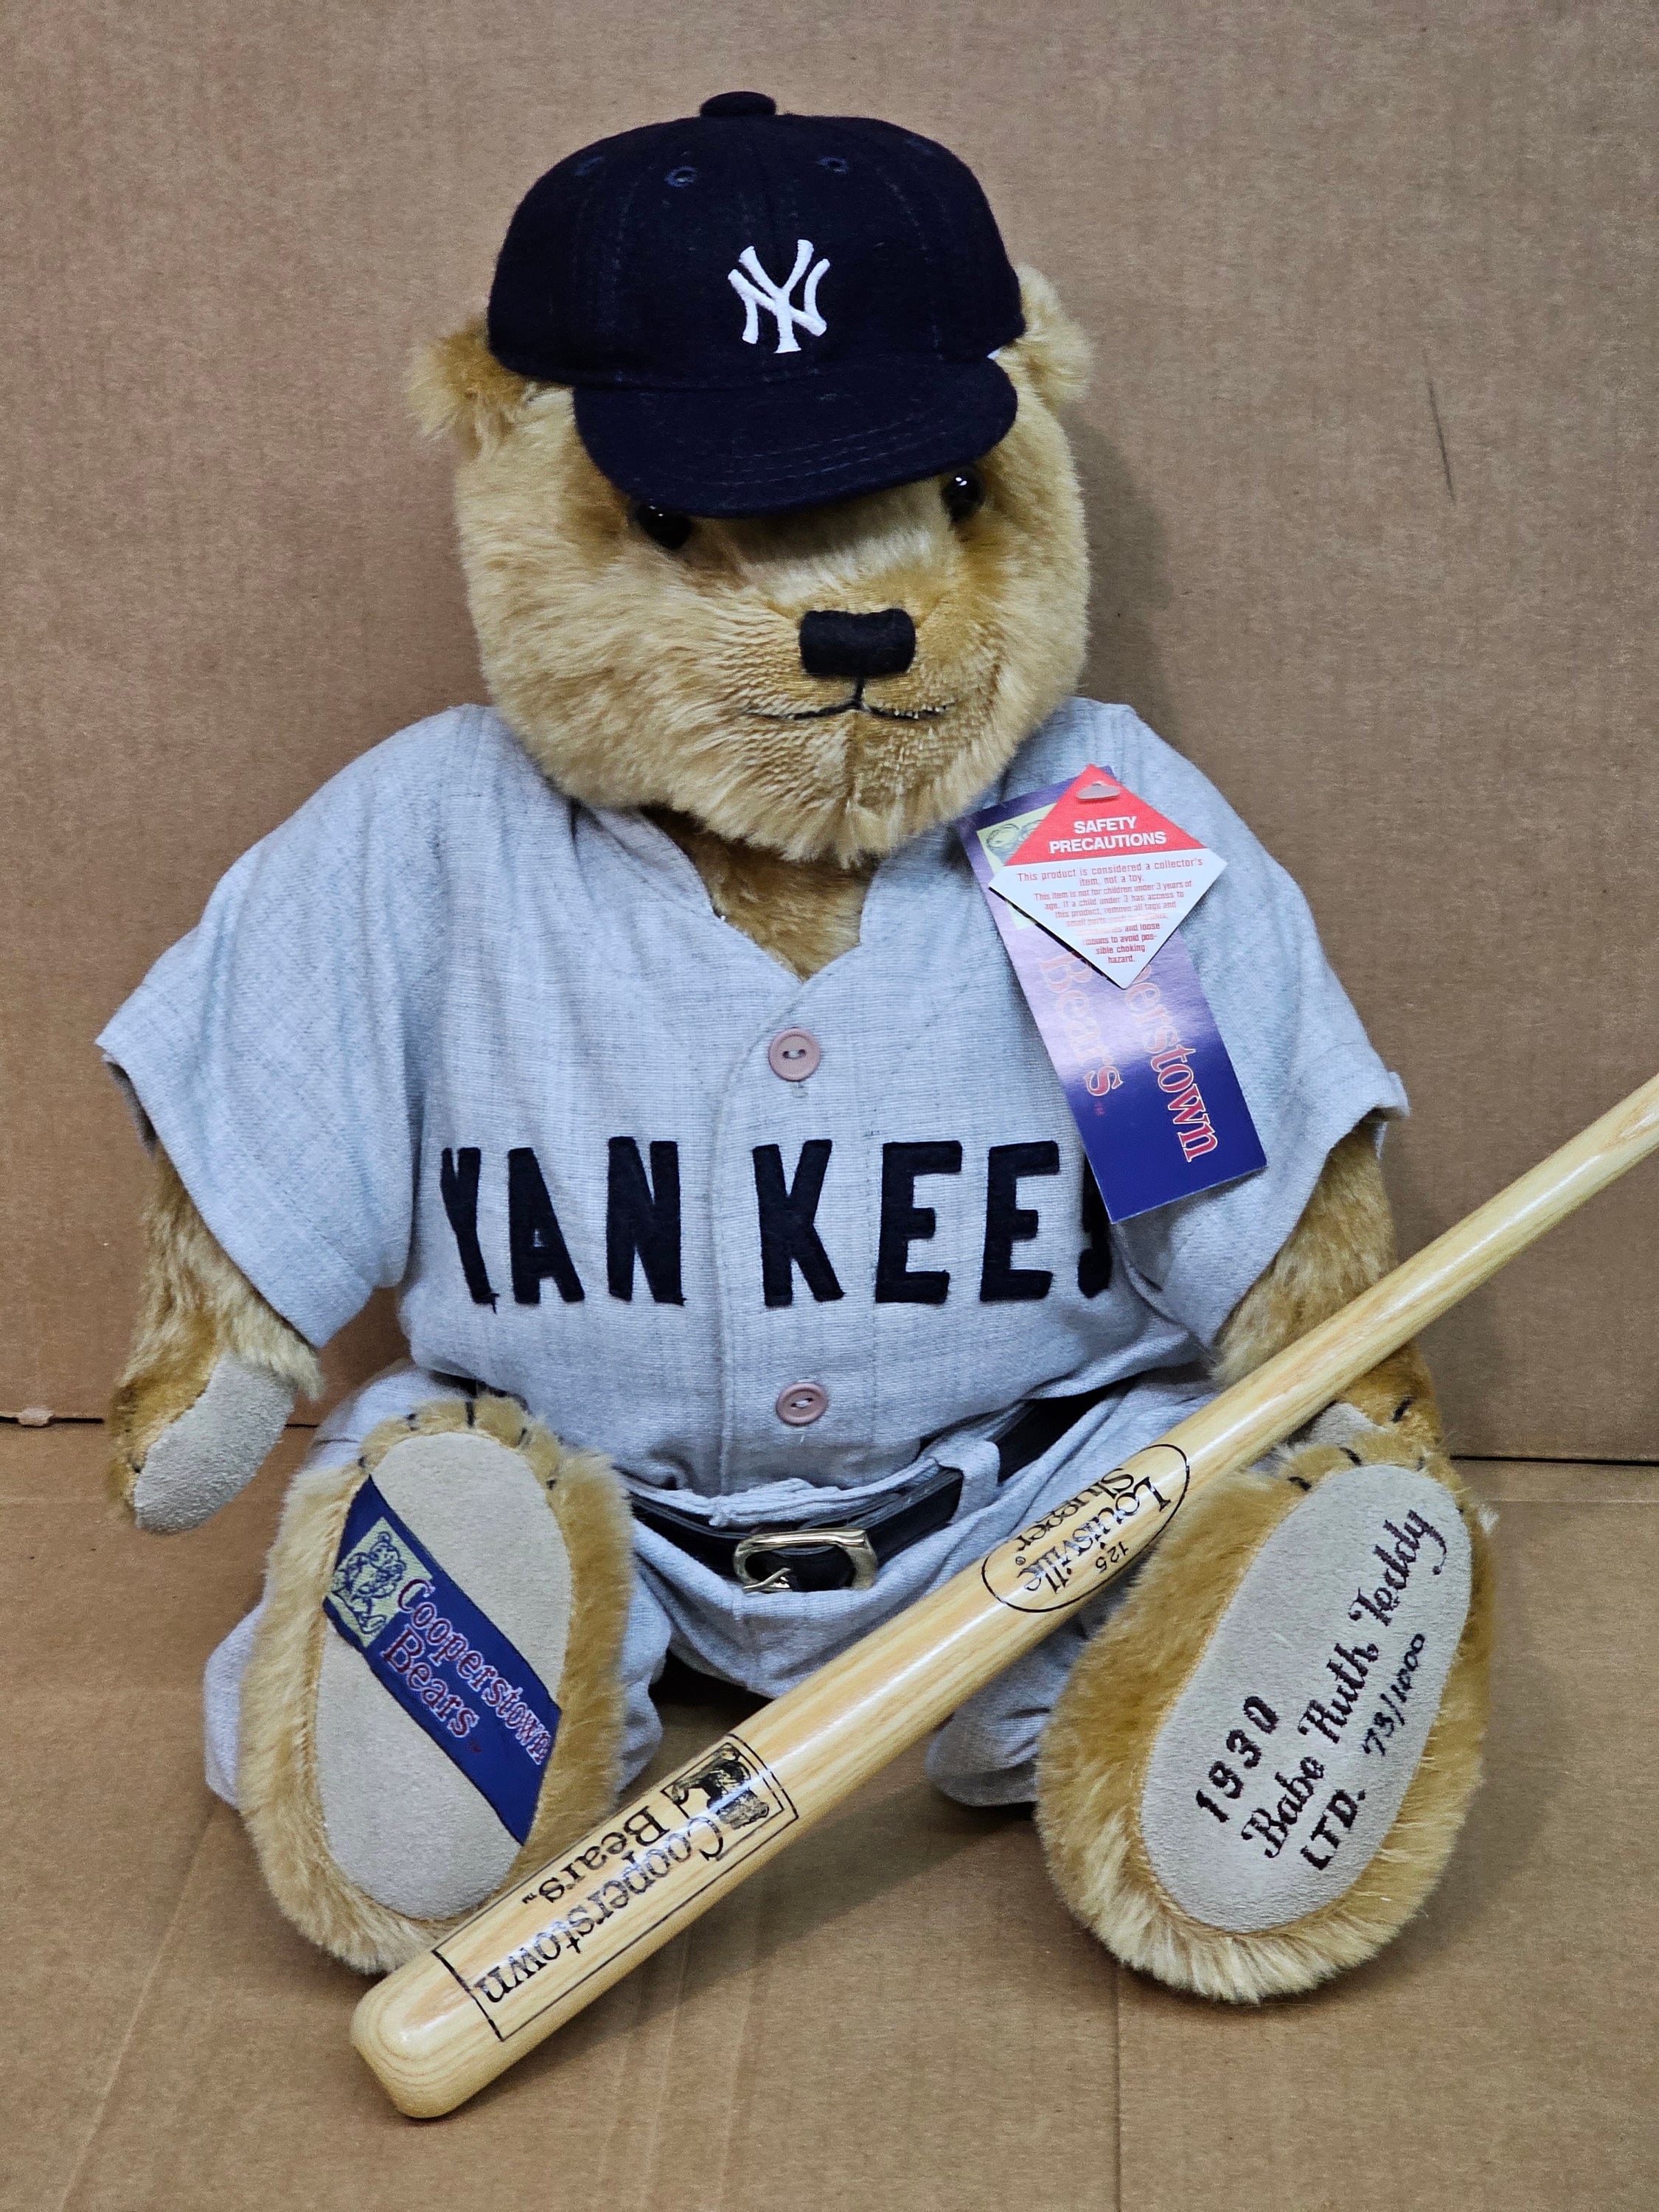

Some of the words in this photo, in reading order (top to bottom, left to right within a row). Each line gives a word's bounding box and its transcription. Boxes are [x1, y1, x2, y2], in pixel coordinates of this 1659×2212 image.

[727, 238, 830, 354] NY
[1074, 815, 1138, 835] SAFETY
[1049, 831, 1167, 854] PRECAUTIONS
[1017, 872, 1038, 882] This
[1042, 869, 1076, 881] product
[1079, 868, 1088, 876] is
[1092, 862, 1142, 875] considered
[1154, 858, 1203, 869] collector's
[1104, 875, 1118, 884] not
[1129, 873, 1145, 883] toy.
[1033, 893, 1051, 901] This
[1052, 891, 1068, 900] item
[1078, 889, 1089, 897] not
[1103, 886, 1132, 894] children
[1134, 883, 1155, 891] under
[1156, 882, 1161, 890] 3
[1163, 881, 1183, 891] years
[1184, 880, 1192, 888] of
[1079, 898, 1096, 906] child
[1099, 896, 1121, 905] under
[1123, 894, 1128, 902] 3
[1131, 894, 1145, 902] has
[1147, 891, 1174, 900] access
[1104, 905, 1132, 914] remove
[1133, 903, 1143, 911] all
[1163, 900, 1177, 909] and
[1110, 935, 1119, 943] to
[1120, 933, 1139, 943] avoid
[1141, 933, 1157, 943] pos-
[1124, 924, 1138, 932] and
[1139, 922, 1161, 931] loose
[1096, 946, 1114, 955] sible
[1116, 944, 1146, 953] choking
[1125, 963, 1220, 1163] erstown
[1016, 1476, 1172, 1595] Louisville
[1095, 1540, 1130, 1574] 125
[397, 1577, 552, 1766] Cooperstown
[1240, 1756, 1325, 1860] Babe
[1297, 1641, 1380, 1745] Ruth
[1348, 1509, 1447, 1627] Teddy
[1195, 1695, 1279, 1823] 1930
[1300, 1788, 1367, 1871] LTD.
[1361, 1632, 1426, 1757] 73/1000
[472, 1815, 725, 2005] Cooperstown
